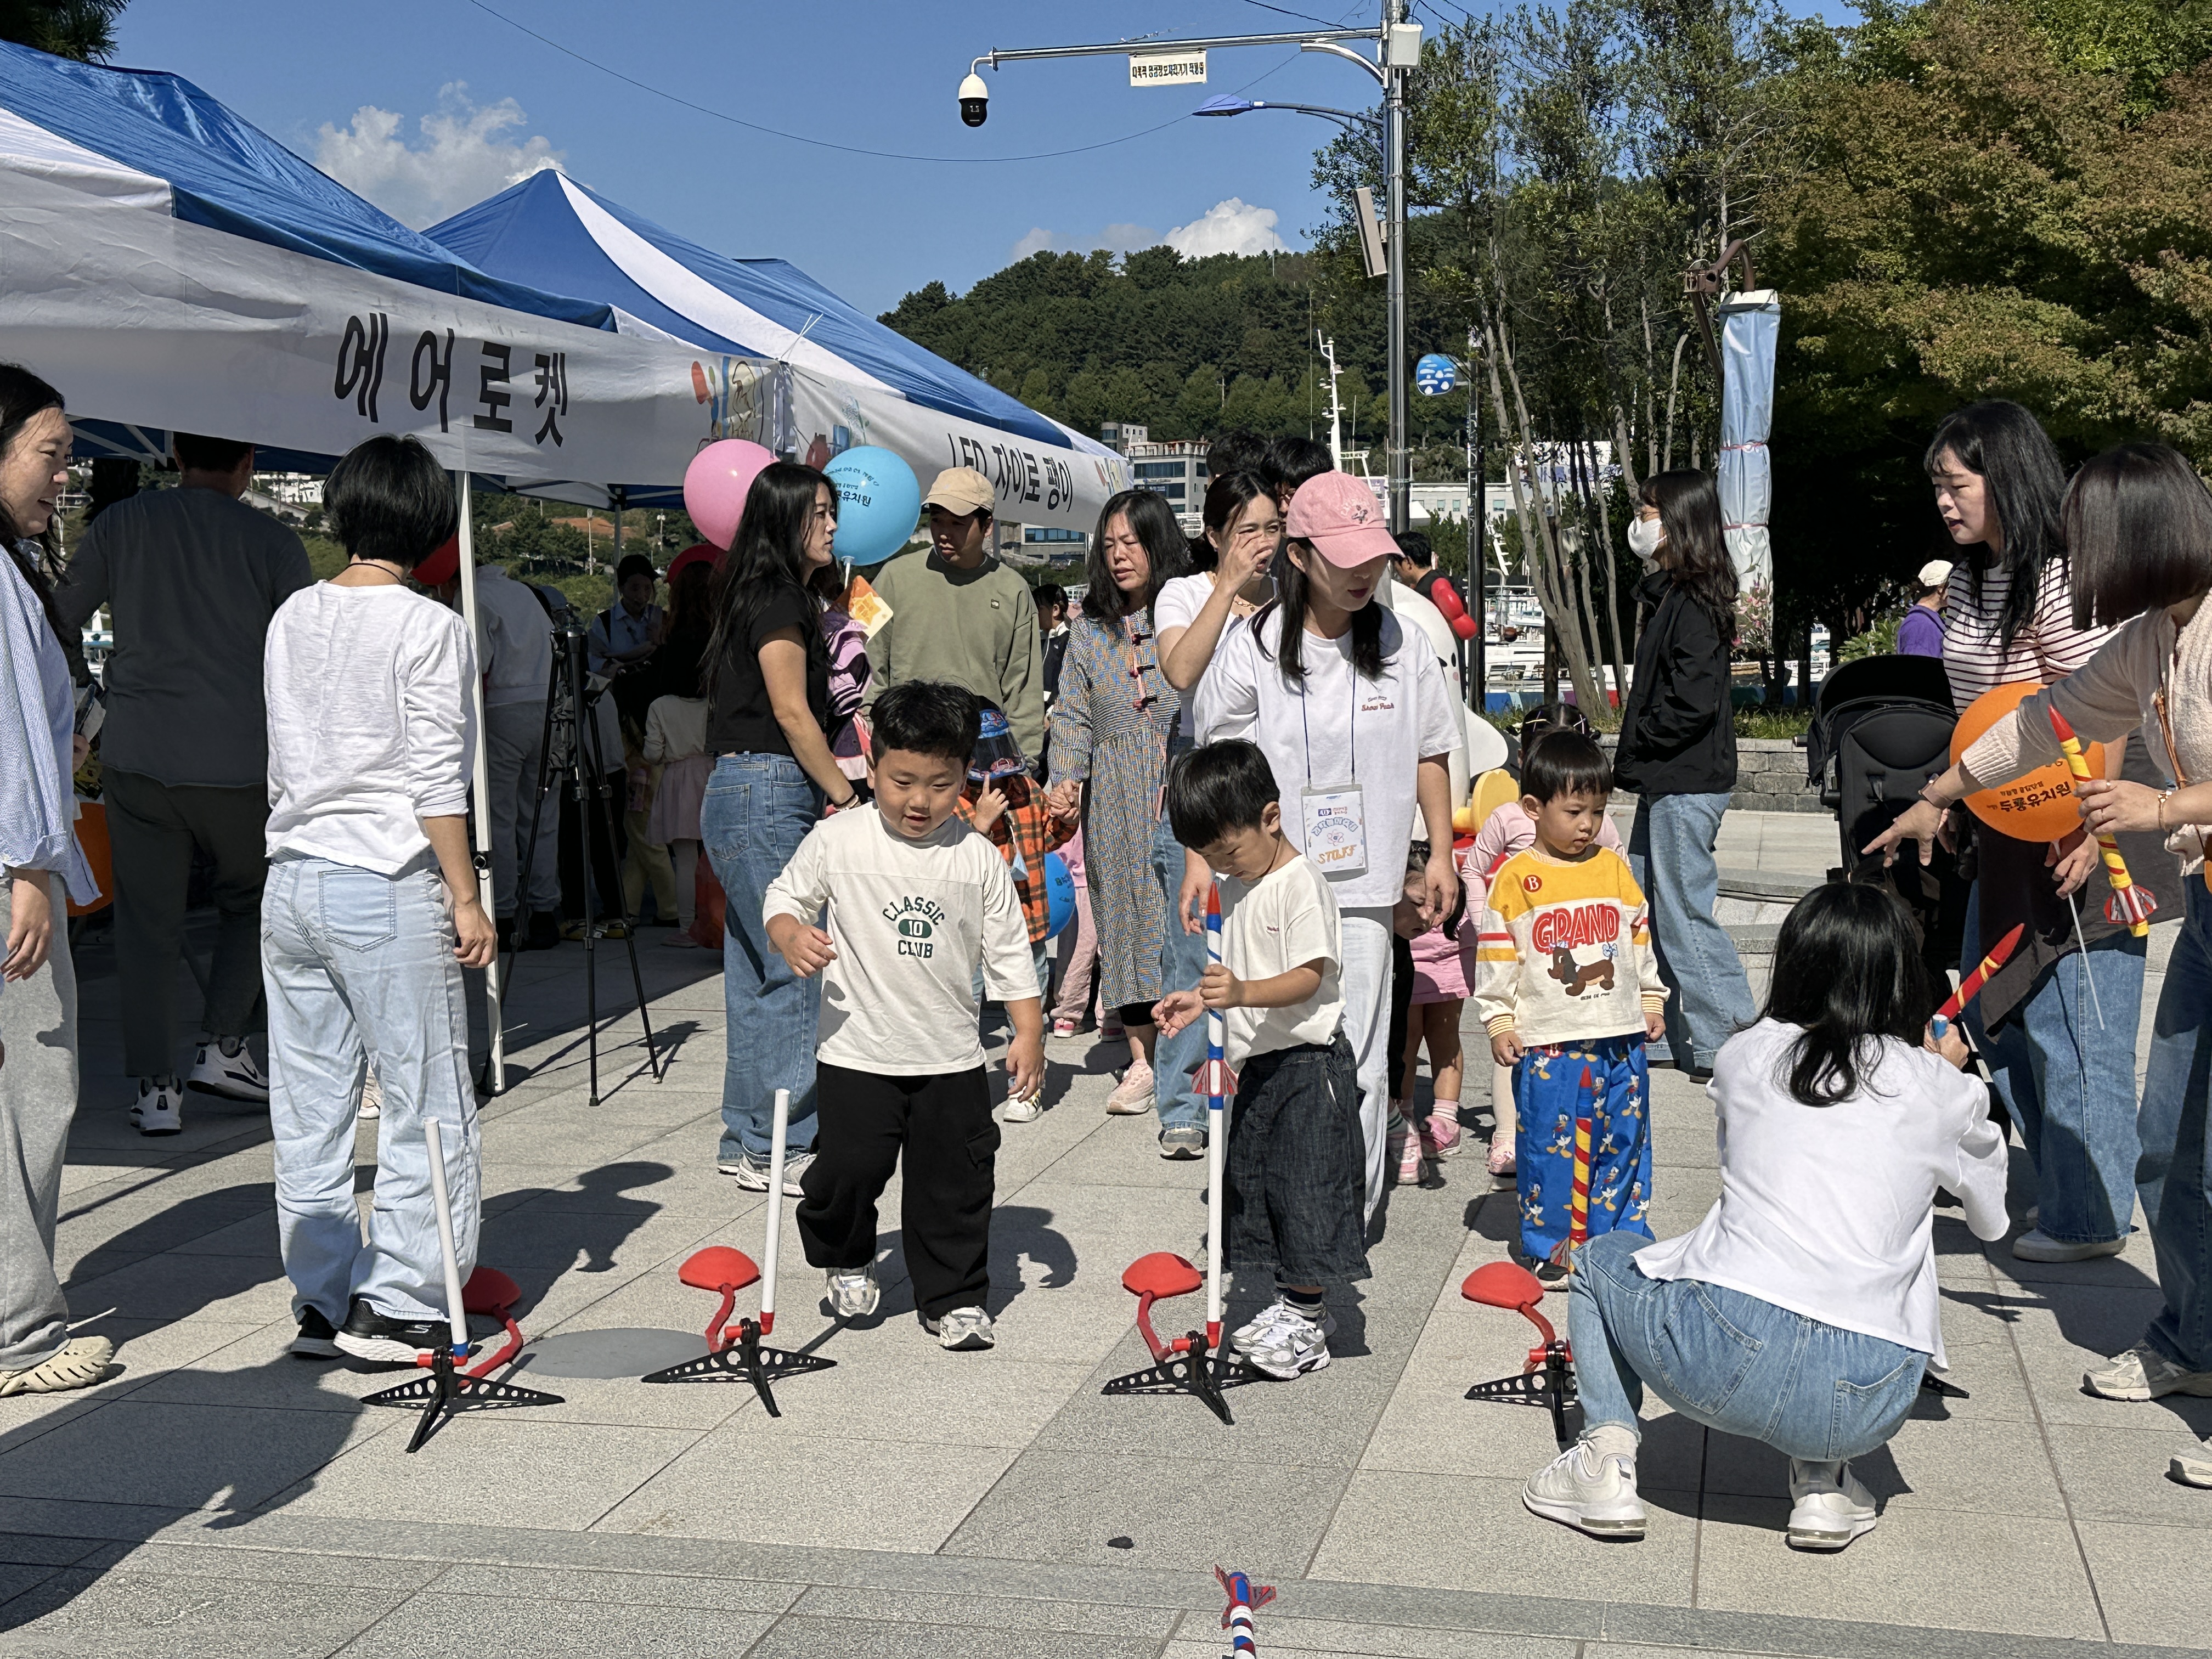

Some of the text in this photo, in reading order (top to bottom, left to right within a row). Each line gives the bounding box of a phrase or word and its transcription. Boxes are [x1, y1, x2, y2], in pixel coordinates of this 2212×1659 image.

[991, 443, 1040, 504] 자이로
[1042, 456, 1073, 512] 팽이
[1528, 876, 1538, 891] B
[883, 896, 945, 925] CLASSIC
[909, 920, 923, 936] 10
[1532, 904, 1620, 955] GRAND
[898, 940, 933, 958] CLUB
